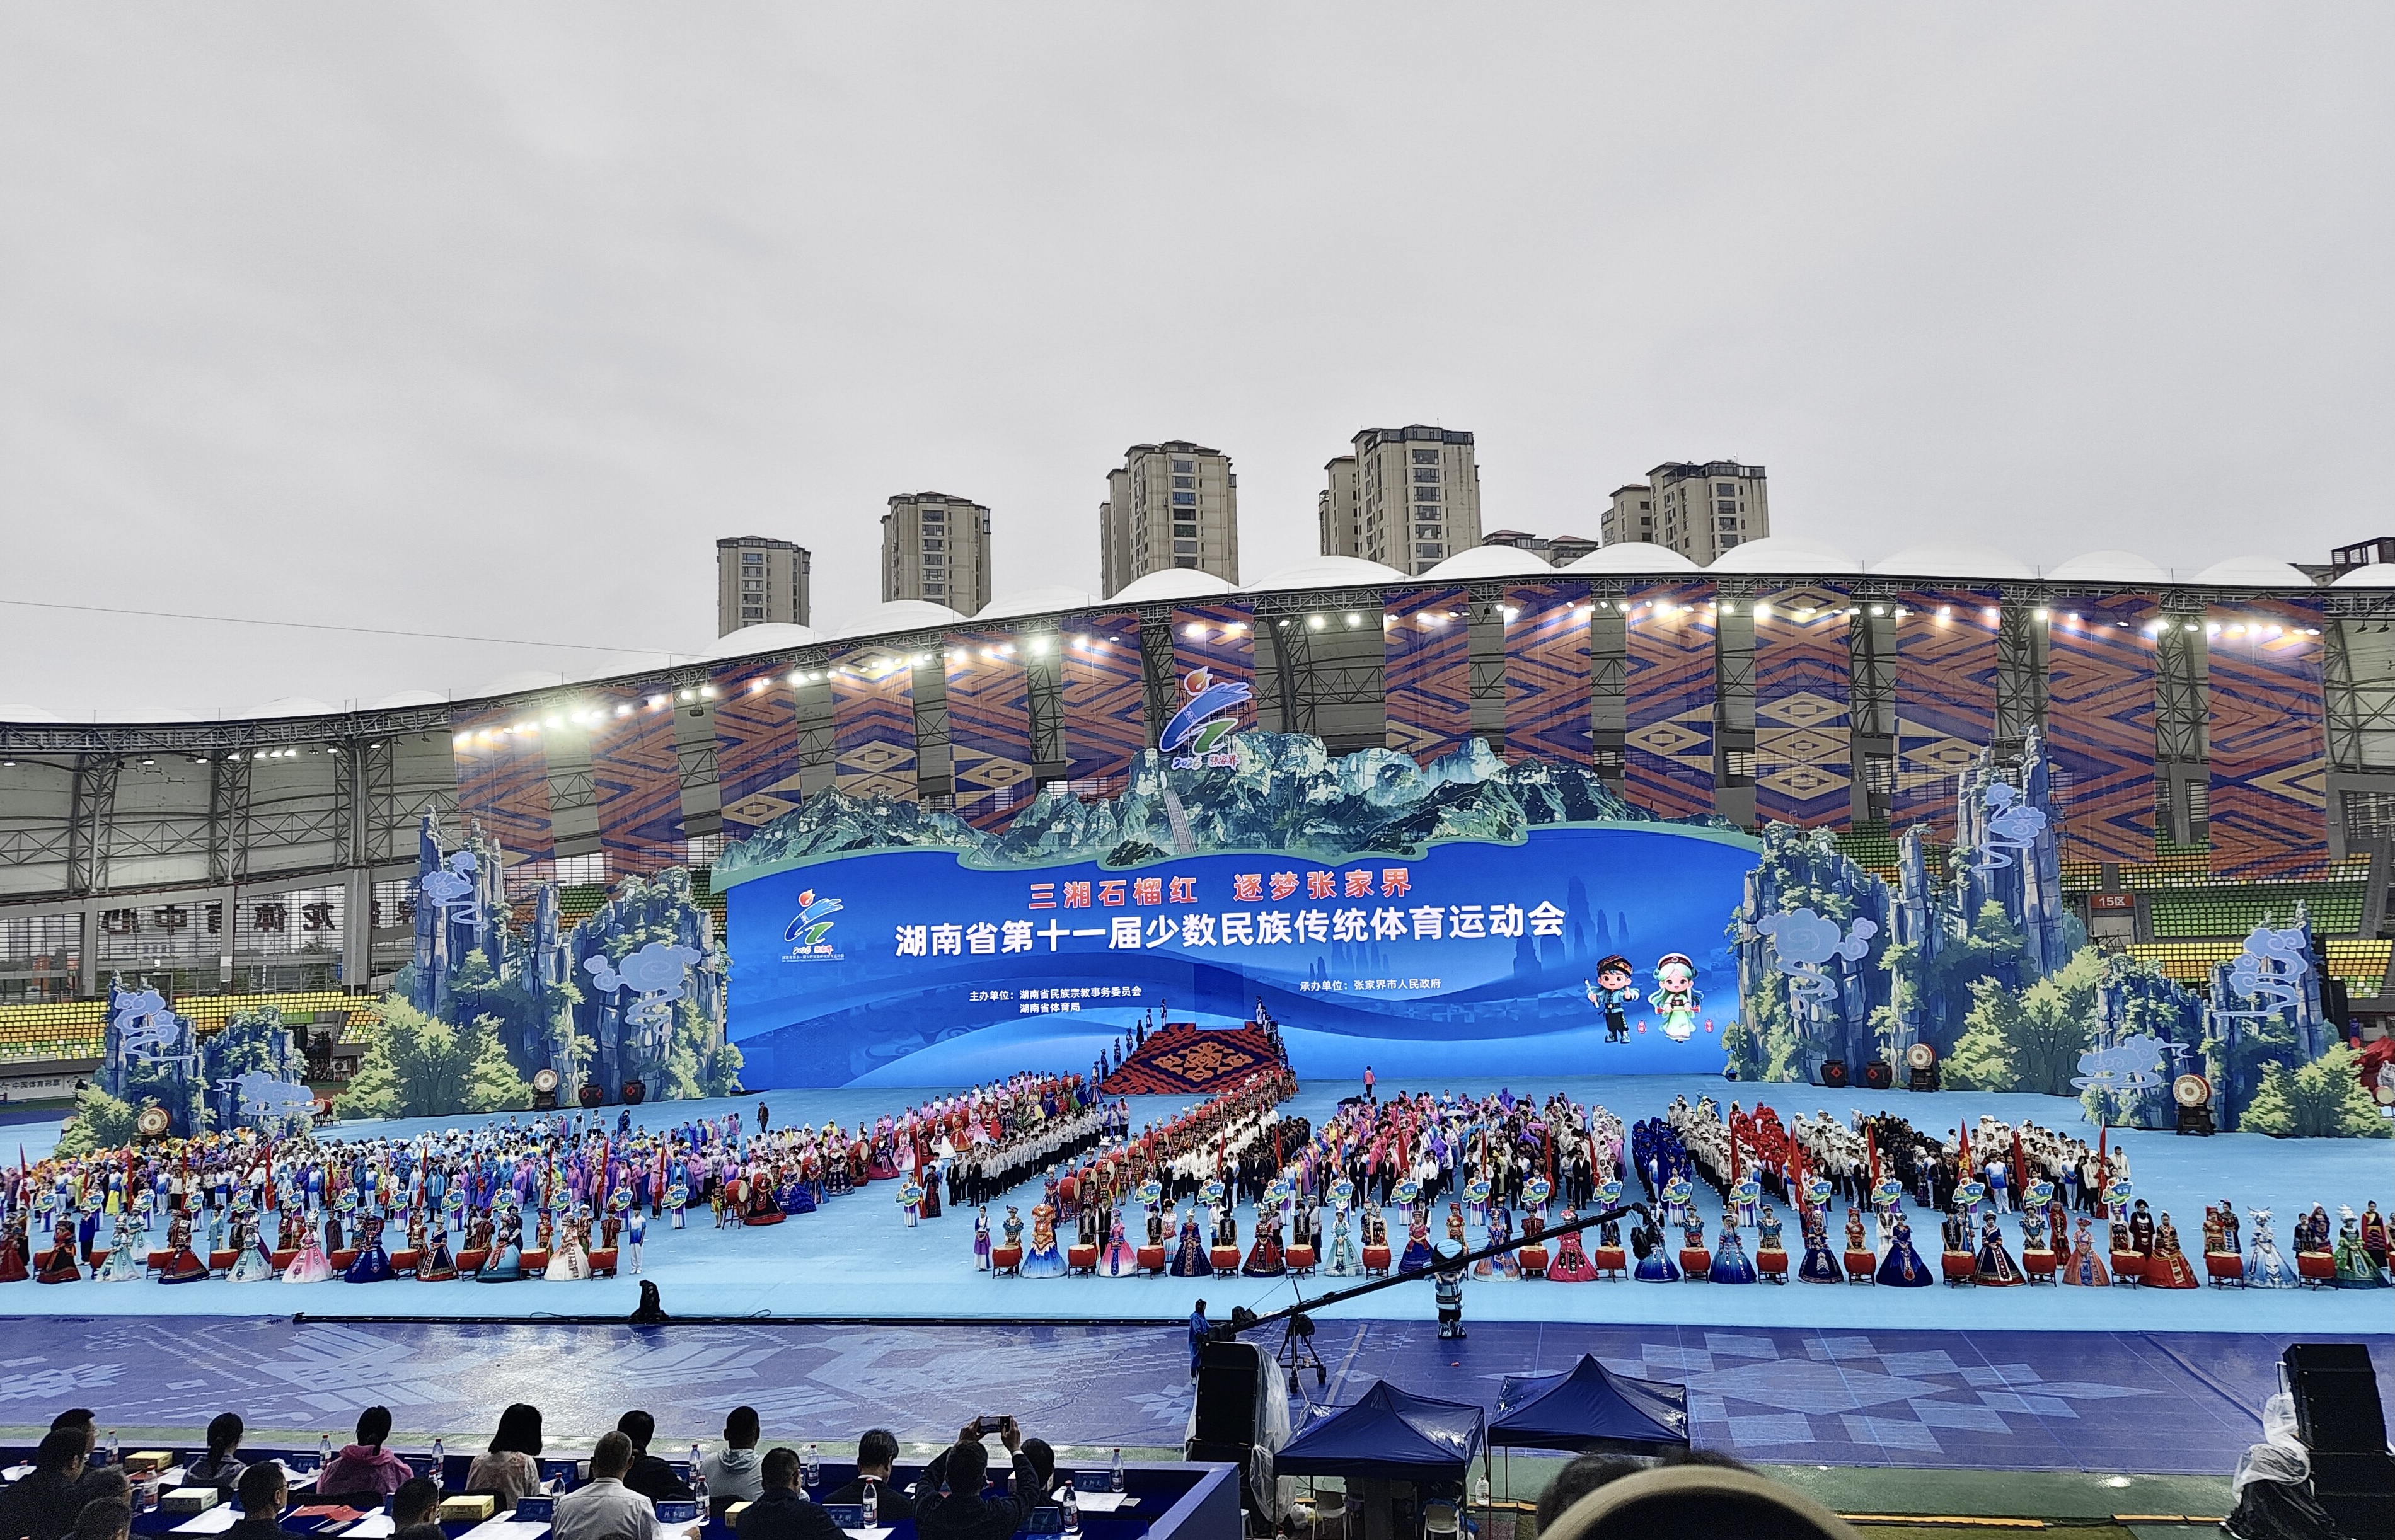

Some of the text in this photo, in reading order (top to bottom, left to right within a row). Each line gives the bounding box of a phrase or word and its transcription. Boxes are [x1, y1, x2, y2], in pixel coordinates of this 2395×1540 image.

[1174, 755, 1239, 769] 2026 张家界
[1029, 868, 1412, 909] 三湘石榴红 逐梦张家界
[2099, 896, 2126, 907] 15区
[895, 900, 1566, 957] 湖南省第十一届少数民族传统体育运动会
[1019, 1002, 1081, 1014] 湖南省体育局
[12, 1079, 61, 1090] 中国体育彩票
